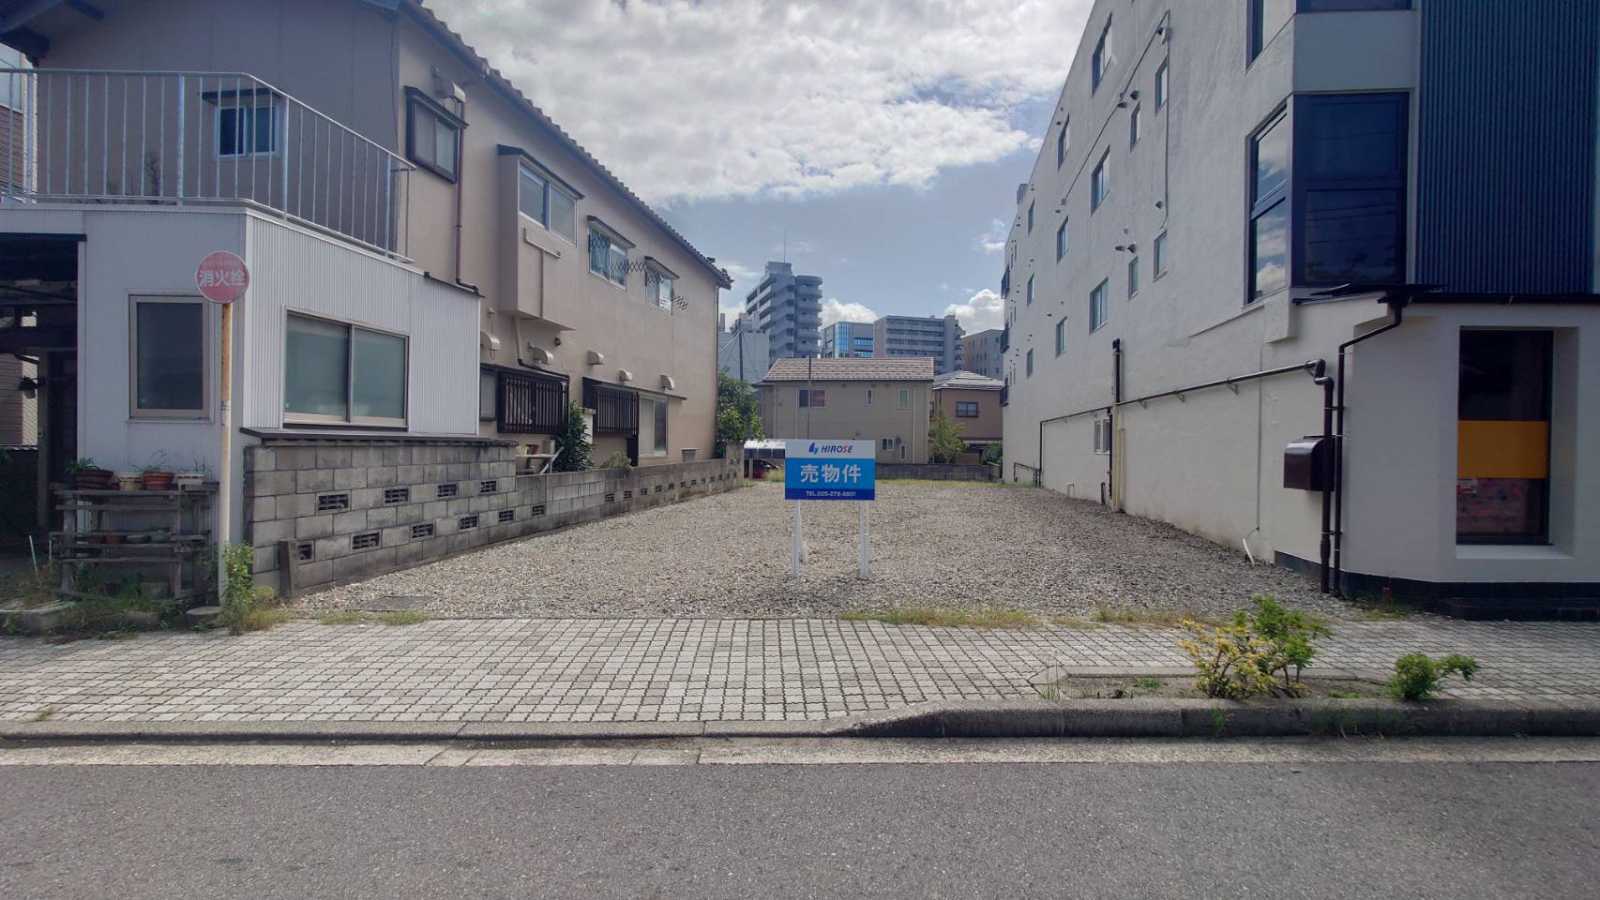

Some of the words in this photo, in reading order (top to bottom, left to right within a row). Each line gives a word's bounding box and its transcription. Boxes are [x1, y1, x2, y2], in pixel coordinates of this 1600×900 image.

[821, 444, 854, 453] HIROSE
[800, 464, 862, 483] 売物件
